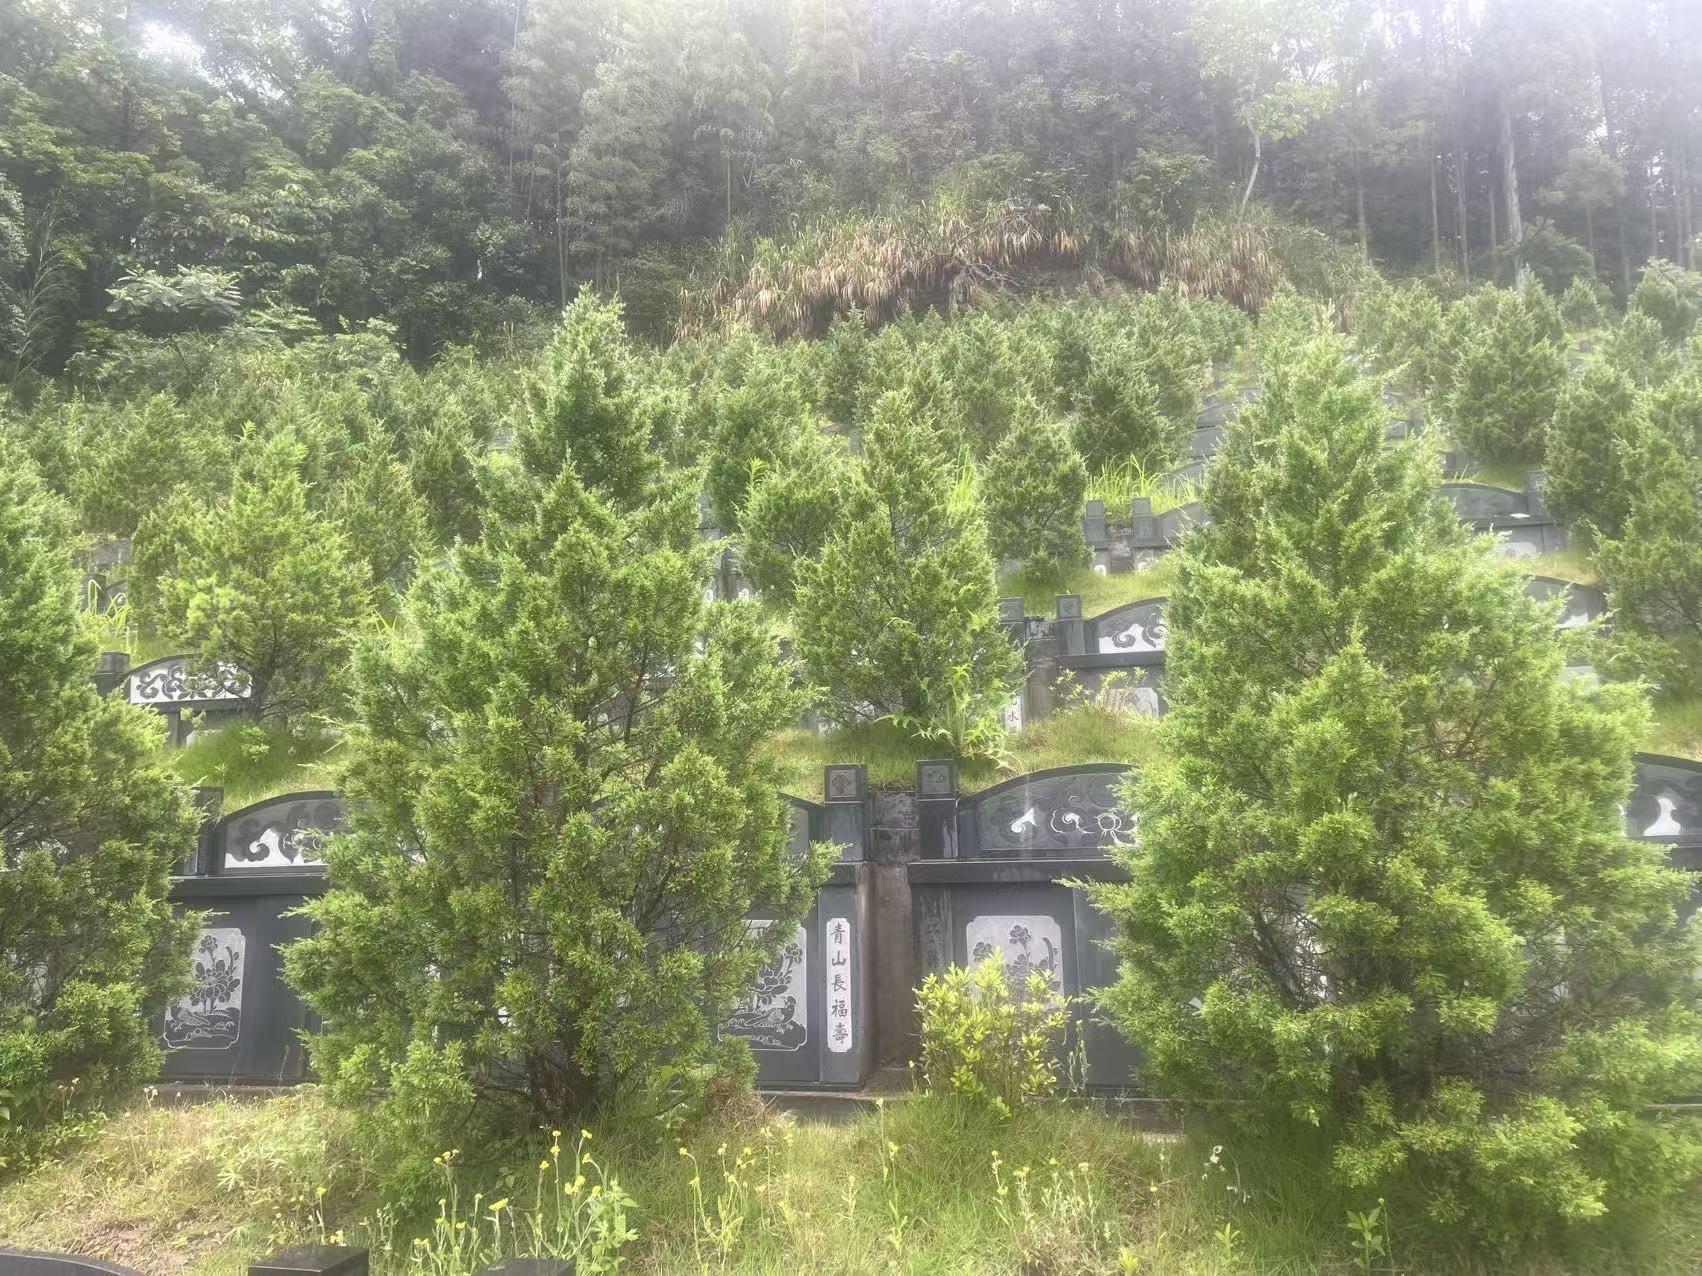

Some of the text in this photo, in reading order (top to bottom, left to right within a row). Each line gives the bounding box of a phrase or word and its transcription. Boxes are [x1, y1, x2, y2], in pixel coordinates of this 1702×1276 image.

[829, 922, 849, 1045] 青山長福壽
